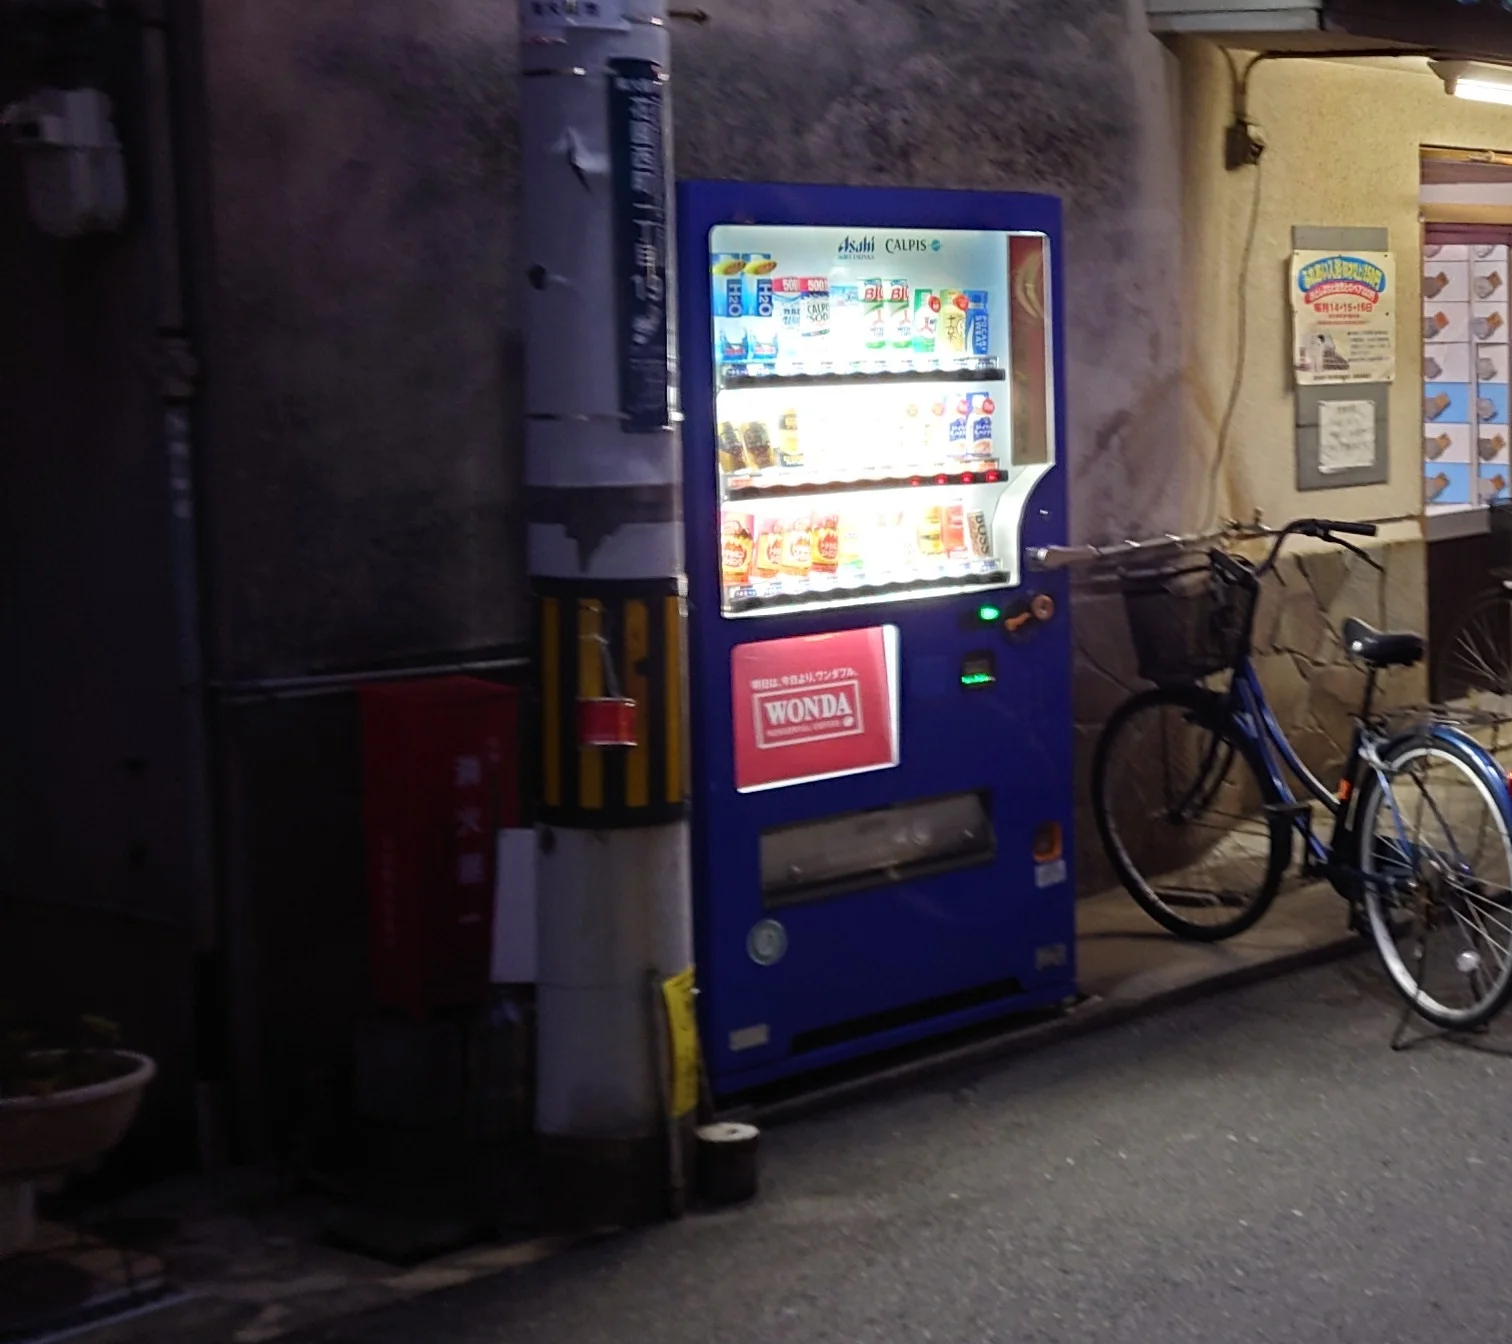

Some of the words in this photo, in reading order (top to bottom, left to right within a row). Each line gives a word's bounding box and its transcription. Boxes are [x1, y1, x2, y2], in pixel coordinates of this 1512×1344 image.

[838, 236, 875, 253] Asahi
[885, 238, 927, 254] CALPIS
[729, 283, 742, 316] H2O
[759, 283, 773, 316] H2O
[764, 691, 853, 726] WONDA
